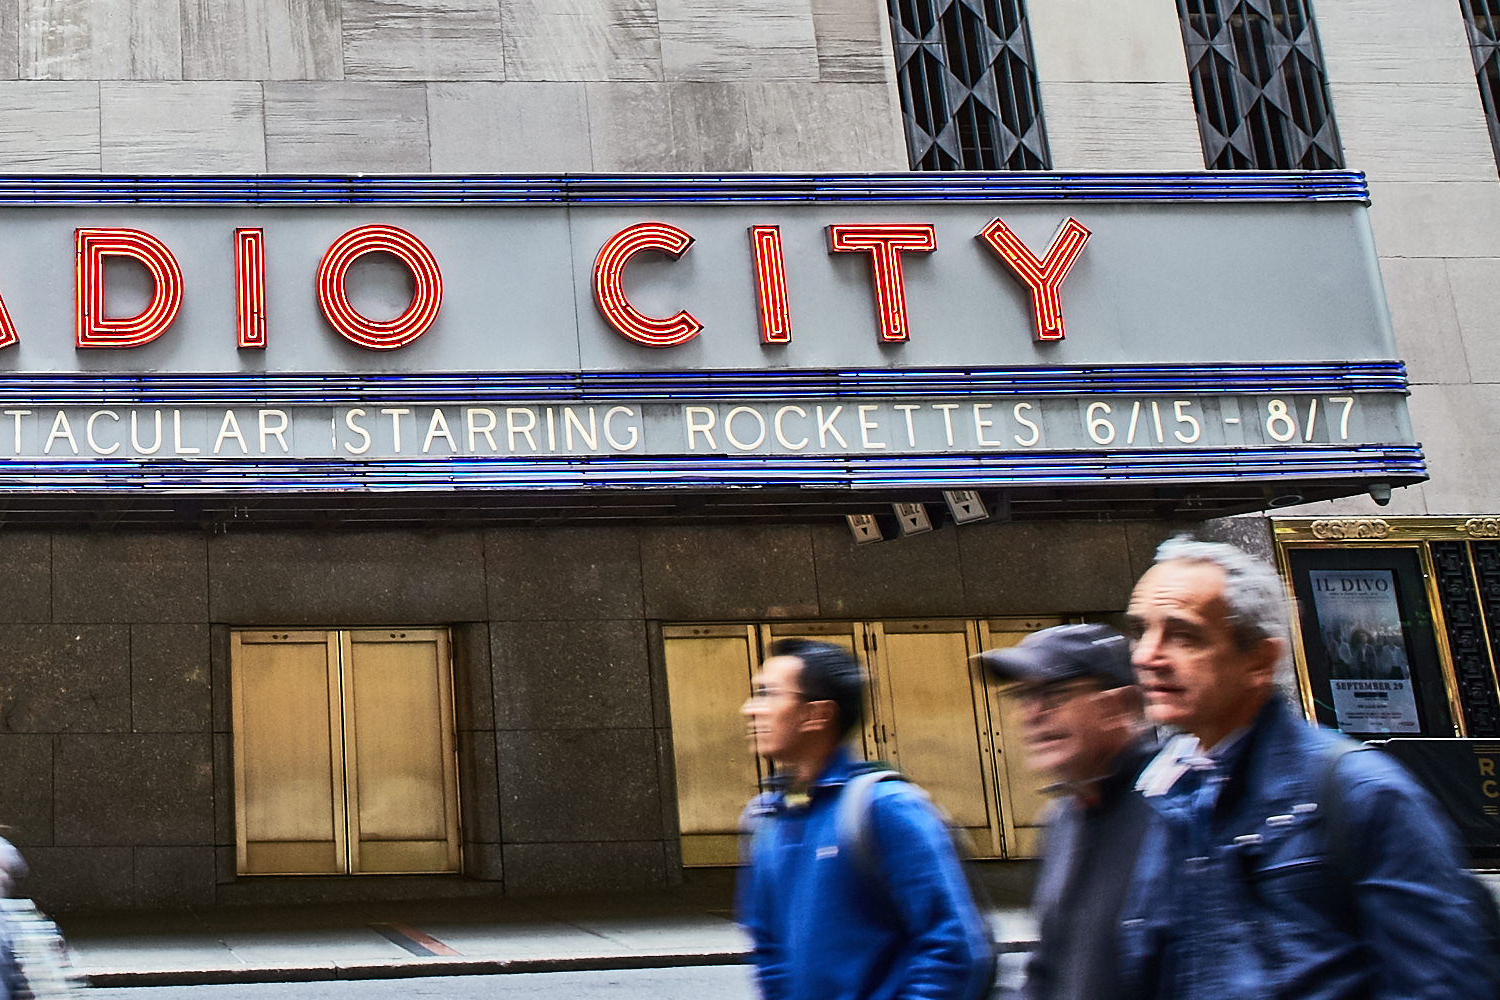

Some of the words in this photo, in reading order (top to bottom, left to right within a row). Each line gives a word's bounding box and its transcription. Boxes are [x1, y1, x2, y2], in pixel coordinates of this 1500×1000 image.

[591, 216, 1092, 348] CITY
[343, 406, 640, 454] STARRING
[685, 402, 1041, 450] ROCKETTES
[1085, 400, 1201, 445] 6/15
[1265, 396, 1355, 442] 8/7
[1315, 578, 1336, 592] IL
[1340, 578, 1389, 592] DIVO
[1335, 681, 1391, 691] SEPTEMBER
[1478, 757, 1496, 776] R
[1482, 779, 1500, 798] C
